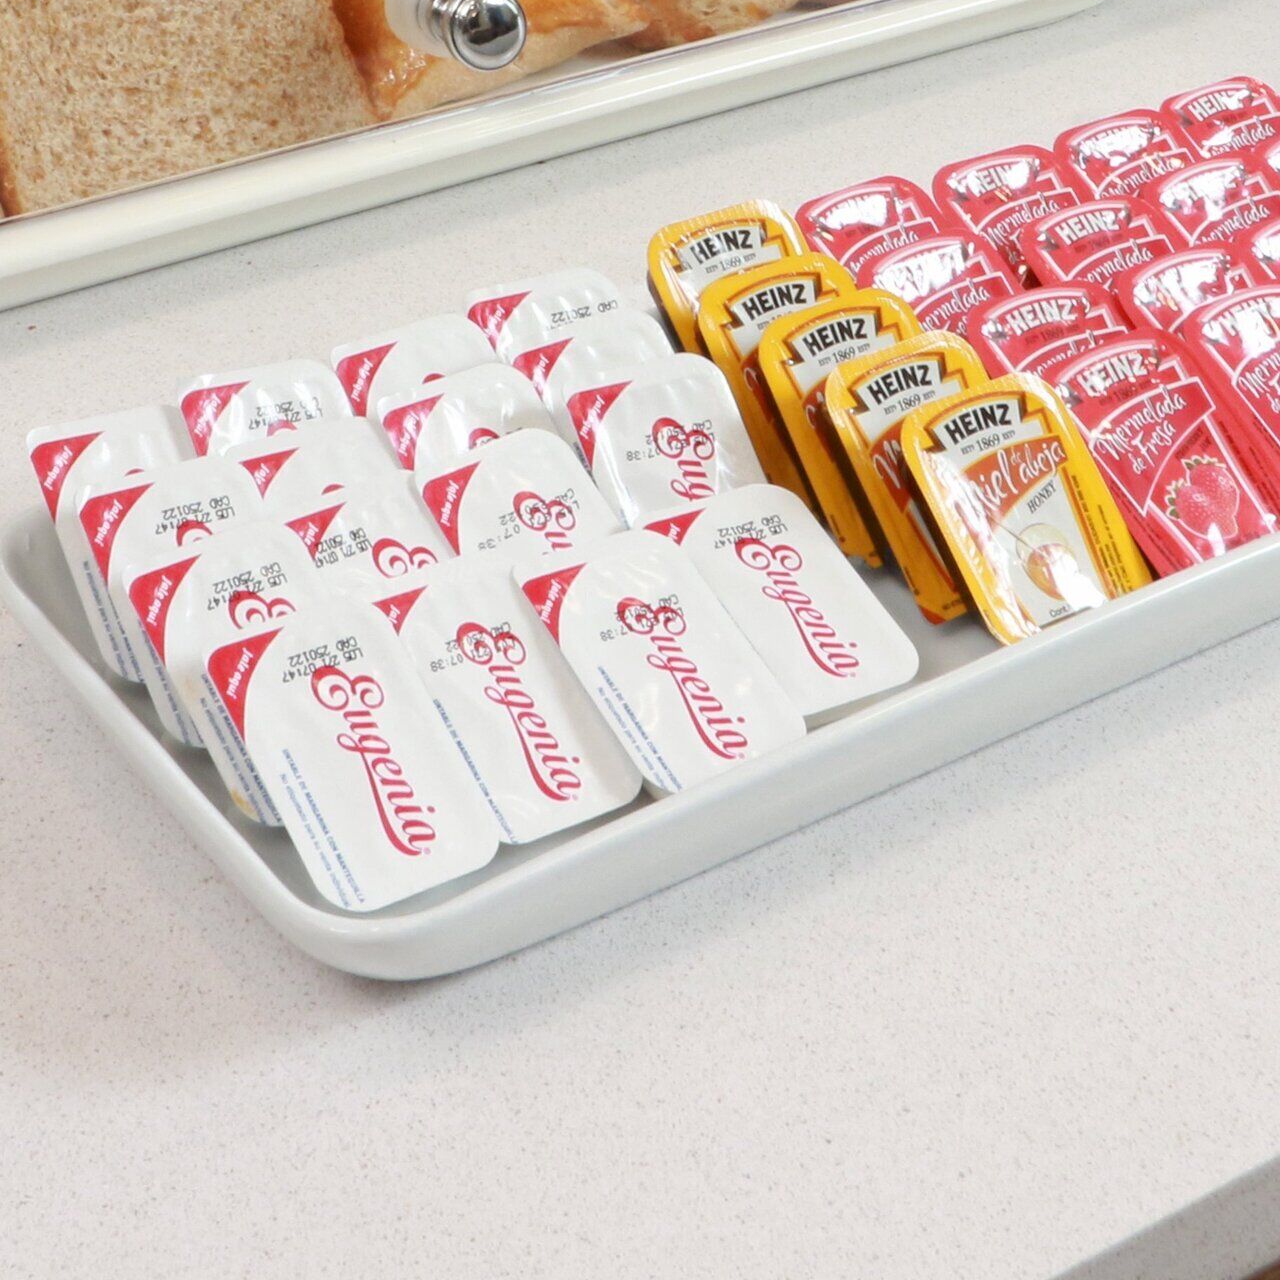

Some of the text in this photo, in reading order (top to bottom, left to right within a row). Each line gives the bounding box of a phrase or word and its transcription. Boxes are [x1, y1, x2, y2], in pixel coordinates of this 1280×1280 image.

[1055, 211, 1119, 245] HEINZ
[690, 229, 753, 265] HEINZ
[741, 283, 808, 321] HEINZ
[1005, 299, 1078, 336] HEINZ
[802, 318, 868, 357] HEINZ
[833, 346, 856, 364] 1869
[867, 364, 933, 405] HEINZ
[1077, 352, 1148, 397] HEINZ
[898, 395, 921, 412] 1869
[1097, 384, 1187, 460] Mermelada
[944, 403, 1012, 445] HEINZ
[976, 433, 1001, 452] 1869
[1019, 440, 1066, 484] abeja
[1130, 421, 1176, 467] Fresa
[162, 495, 230, 520] CAD 250122
[1027, 480, 1057, 514] HONEY
[717, 515, 781, 537] CAD 250122
[212, 562, 282, 594] CAD 250122
[734, 537, 860, 678] Eugenia
[288, 636, 357, 667] CAD 250122
[430, 656, 464, 673] 07:38
[616, 597, 748, 760] Eugenia
[456, 621, 582, 802] Eugenia
[310, 665, 437, 857] Eugenia
